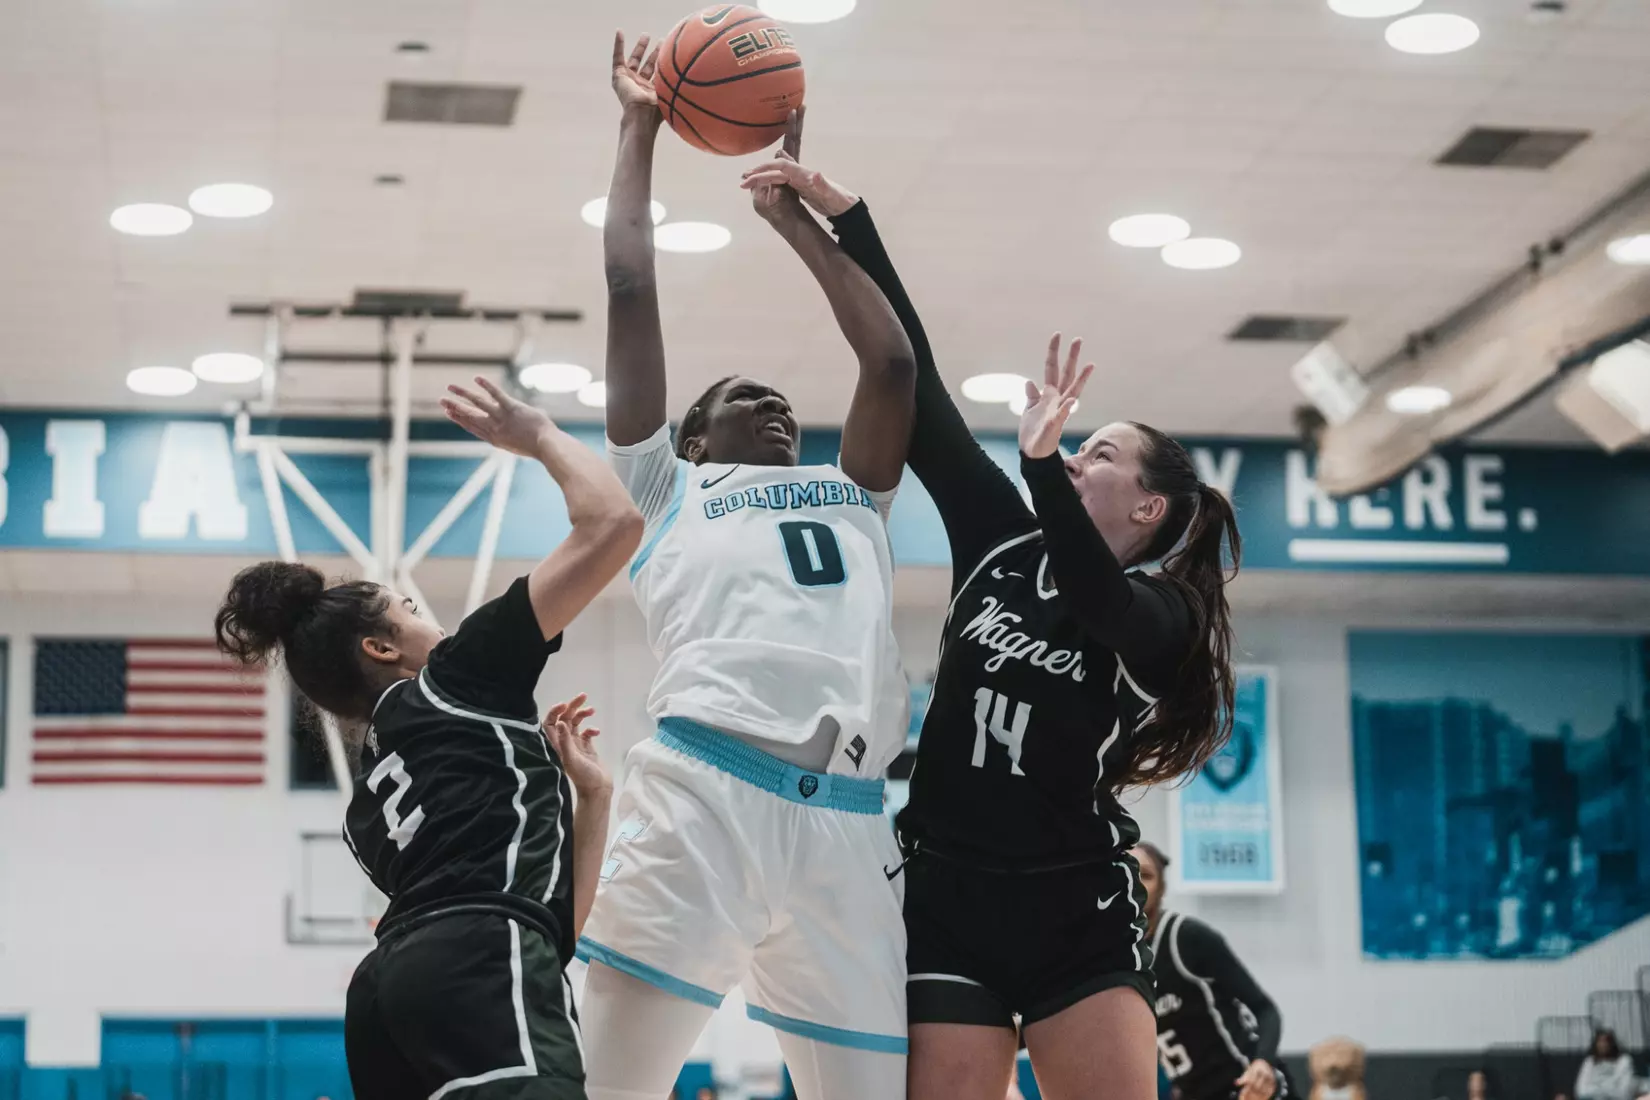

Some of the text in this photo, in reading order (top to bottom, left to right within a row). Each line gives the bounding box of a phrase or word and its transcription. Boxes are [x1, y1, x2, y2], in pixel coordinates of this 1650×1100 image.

[727, 28, 796, 60] ELITE
[0, 418, 247, 540] IA
[776, 520, 848, 588] 0
[959, 595, 1087, 683] Wagner
[971, 686, 1033, 777] 14
[366, 750, 427, 852] 2
